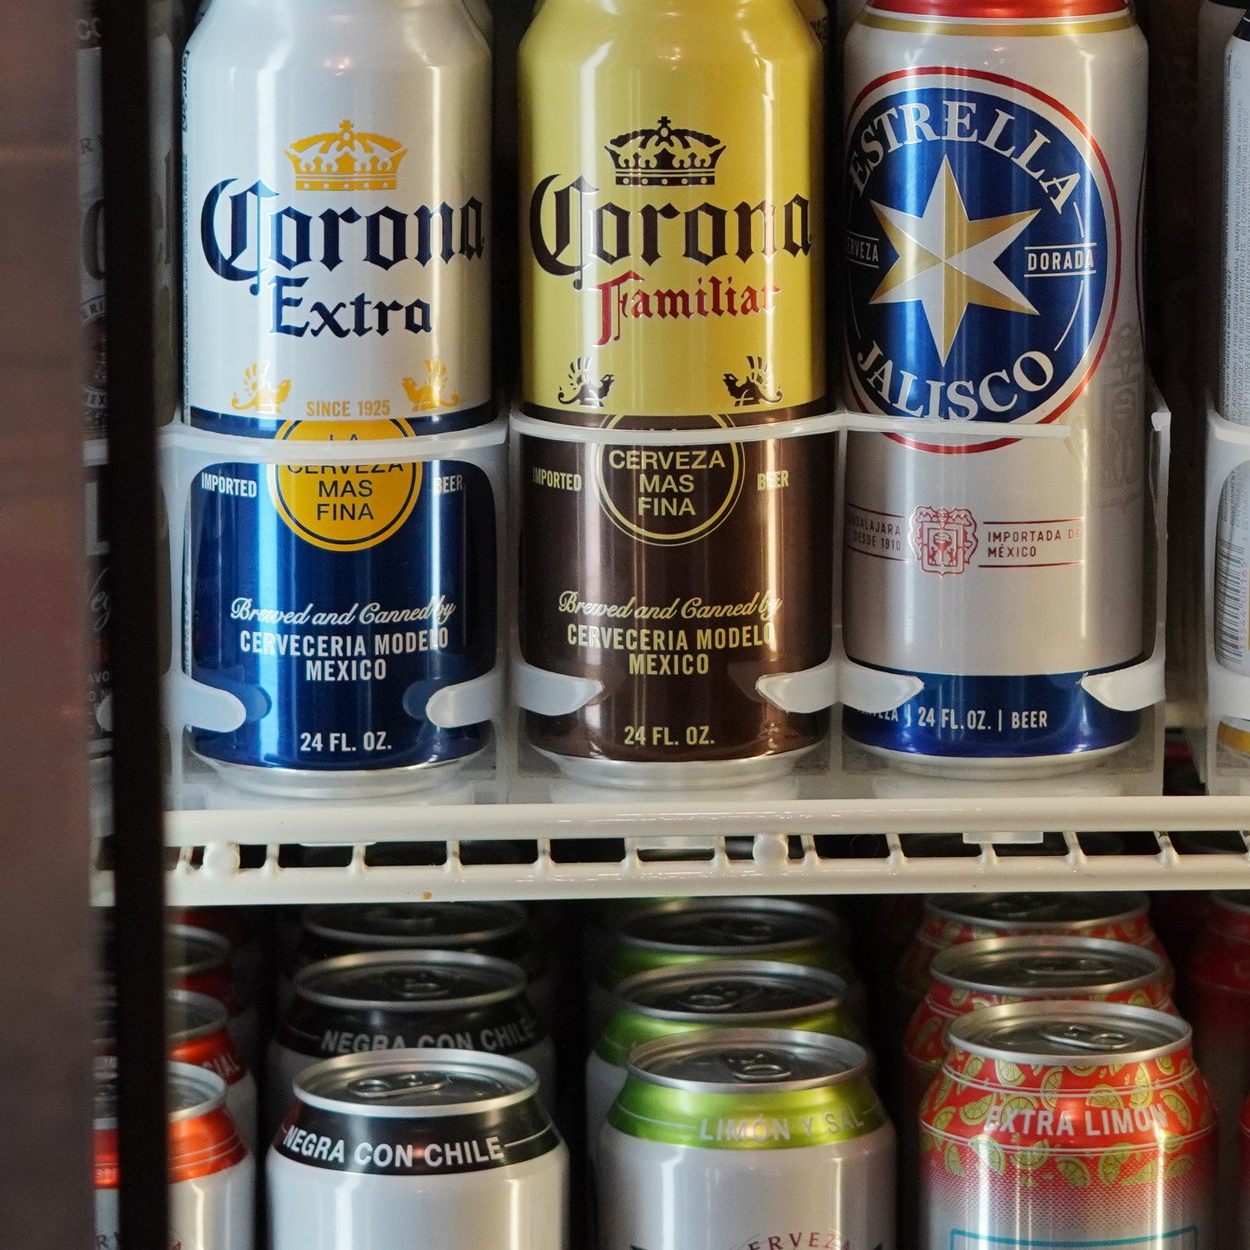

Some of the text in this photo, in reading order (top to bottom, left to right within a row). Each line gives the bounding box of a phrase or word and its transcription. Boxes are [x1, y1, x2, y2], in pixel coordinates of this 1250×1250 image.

[848, 99, 1082, 215] ESTRELLA
[200, 177, 486, 297] Corona
[529, 173, 816, 292] Corona
[1027, 249, 1095, 273] DORADA
[267, 274, 434, 339] Extra
[588, 269, 782, 348] Familiar
[857, 339, 1054, 423] JALISCO
[306, 399, 391, 418] SINCE 1925
[609, 450, 726, 470] CERVEZA
[201, 471, 258, 499] IMPORTED
[317, 479, 374, 498] MAS
[434, 474, 465, 496] BEER
[532, 466, 583, 493] IMPORTED
[638, 474, 695, 494] MAS
[757, 470, 790, 492] BEER
[316, 503, 375, 521] FINA
[637, 497, 697, 517] FINA
[987, 530, 1061, 543] IMPORTADA
[987, 543, 1037, 558] MÉXICO
[229, 596, 359, 626] Brewed and
[558, 590, 762, 620] Brewed and Canned
[240, 627, 449, 658] CERVECERIA MODELO
[567, 622, 775, 651] CERVECERIA MODELO
[305, 658, 387, 682] MEXICO
[628, 653, 709, 676] MEXICO
[917, 707, 936, 728] 24
[1011, 711, 1048, 730] BEER
[300, 731, 393, 752] 24 FL. OZ.
[624, 727, 715, 745] 24 FL. OZ.
[416, 1021, 533, 1051] CON CHILE
[699, 1111, 864, 1142] LIMÓN Y SAL
[986, 1105, 1075, 1137] EXTRA
[283, 1124, 505, 1168] NEGRA CON CHILE
